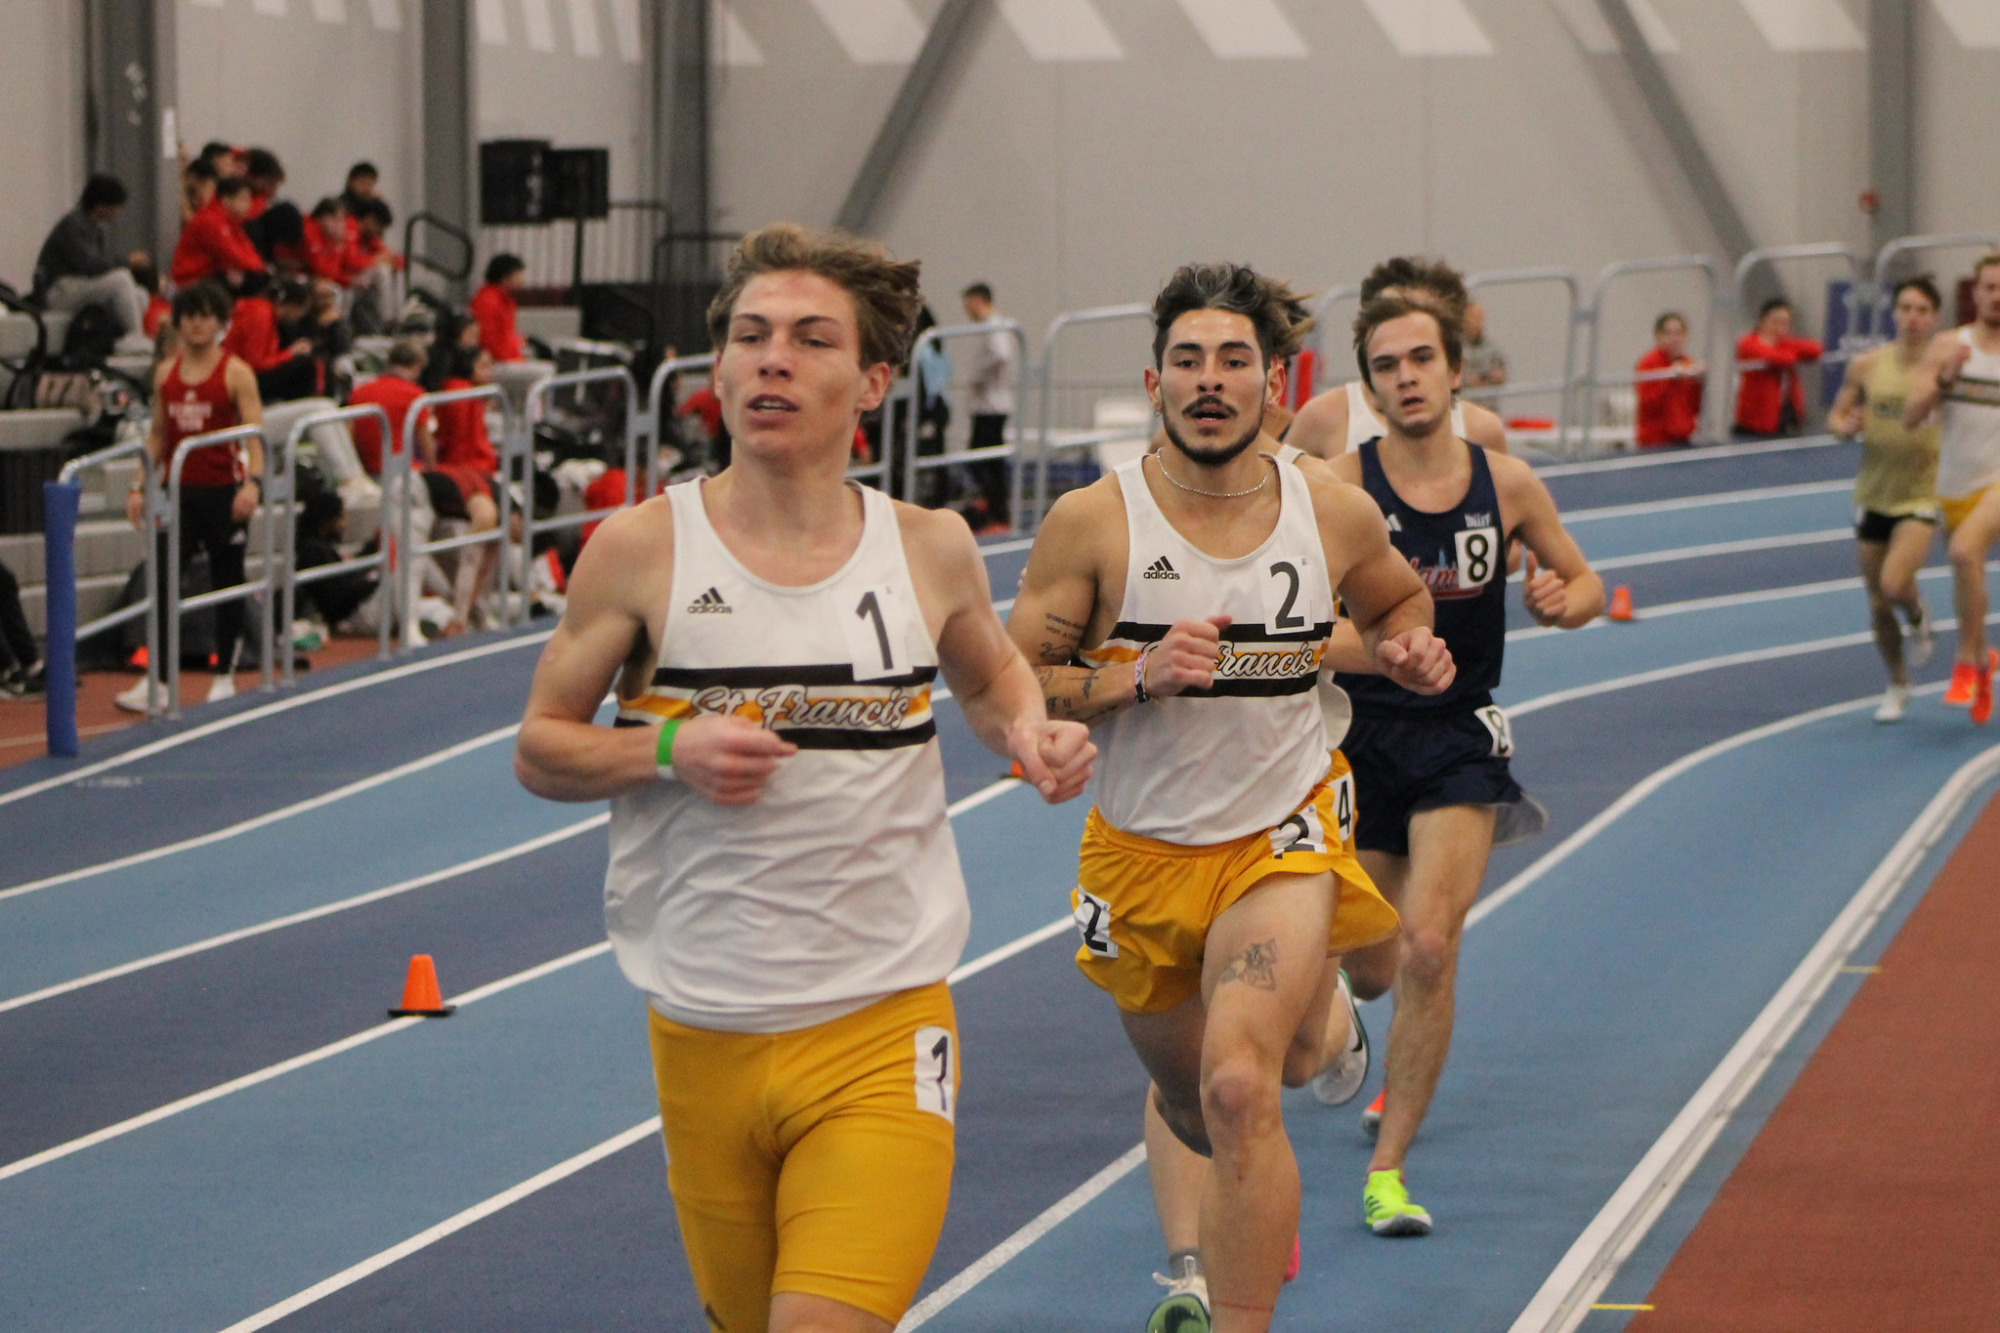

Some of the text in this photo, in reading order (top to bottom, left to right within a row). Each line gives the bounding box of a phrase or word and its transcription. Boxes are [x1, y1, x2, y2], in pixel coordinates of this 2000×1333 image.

[1143, 570, 1180, 580] adidas
[1465, 533, 1489, 583] 8
[687, 604, 733, 614] adidas
[1269, 561, 1305, 629] 2
[855, 591, 894, 670] 1
[1214, 640, 1314, 677] rancis
[690, 684, 910, 730] St Francis
[1338, 780, 1351, 834] 4
[1274, 813, 1315, 860] 2
[1083, 894, 1107, 953] 2
[931, 1034, 948, 1113] 1
